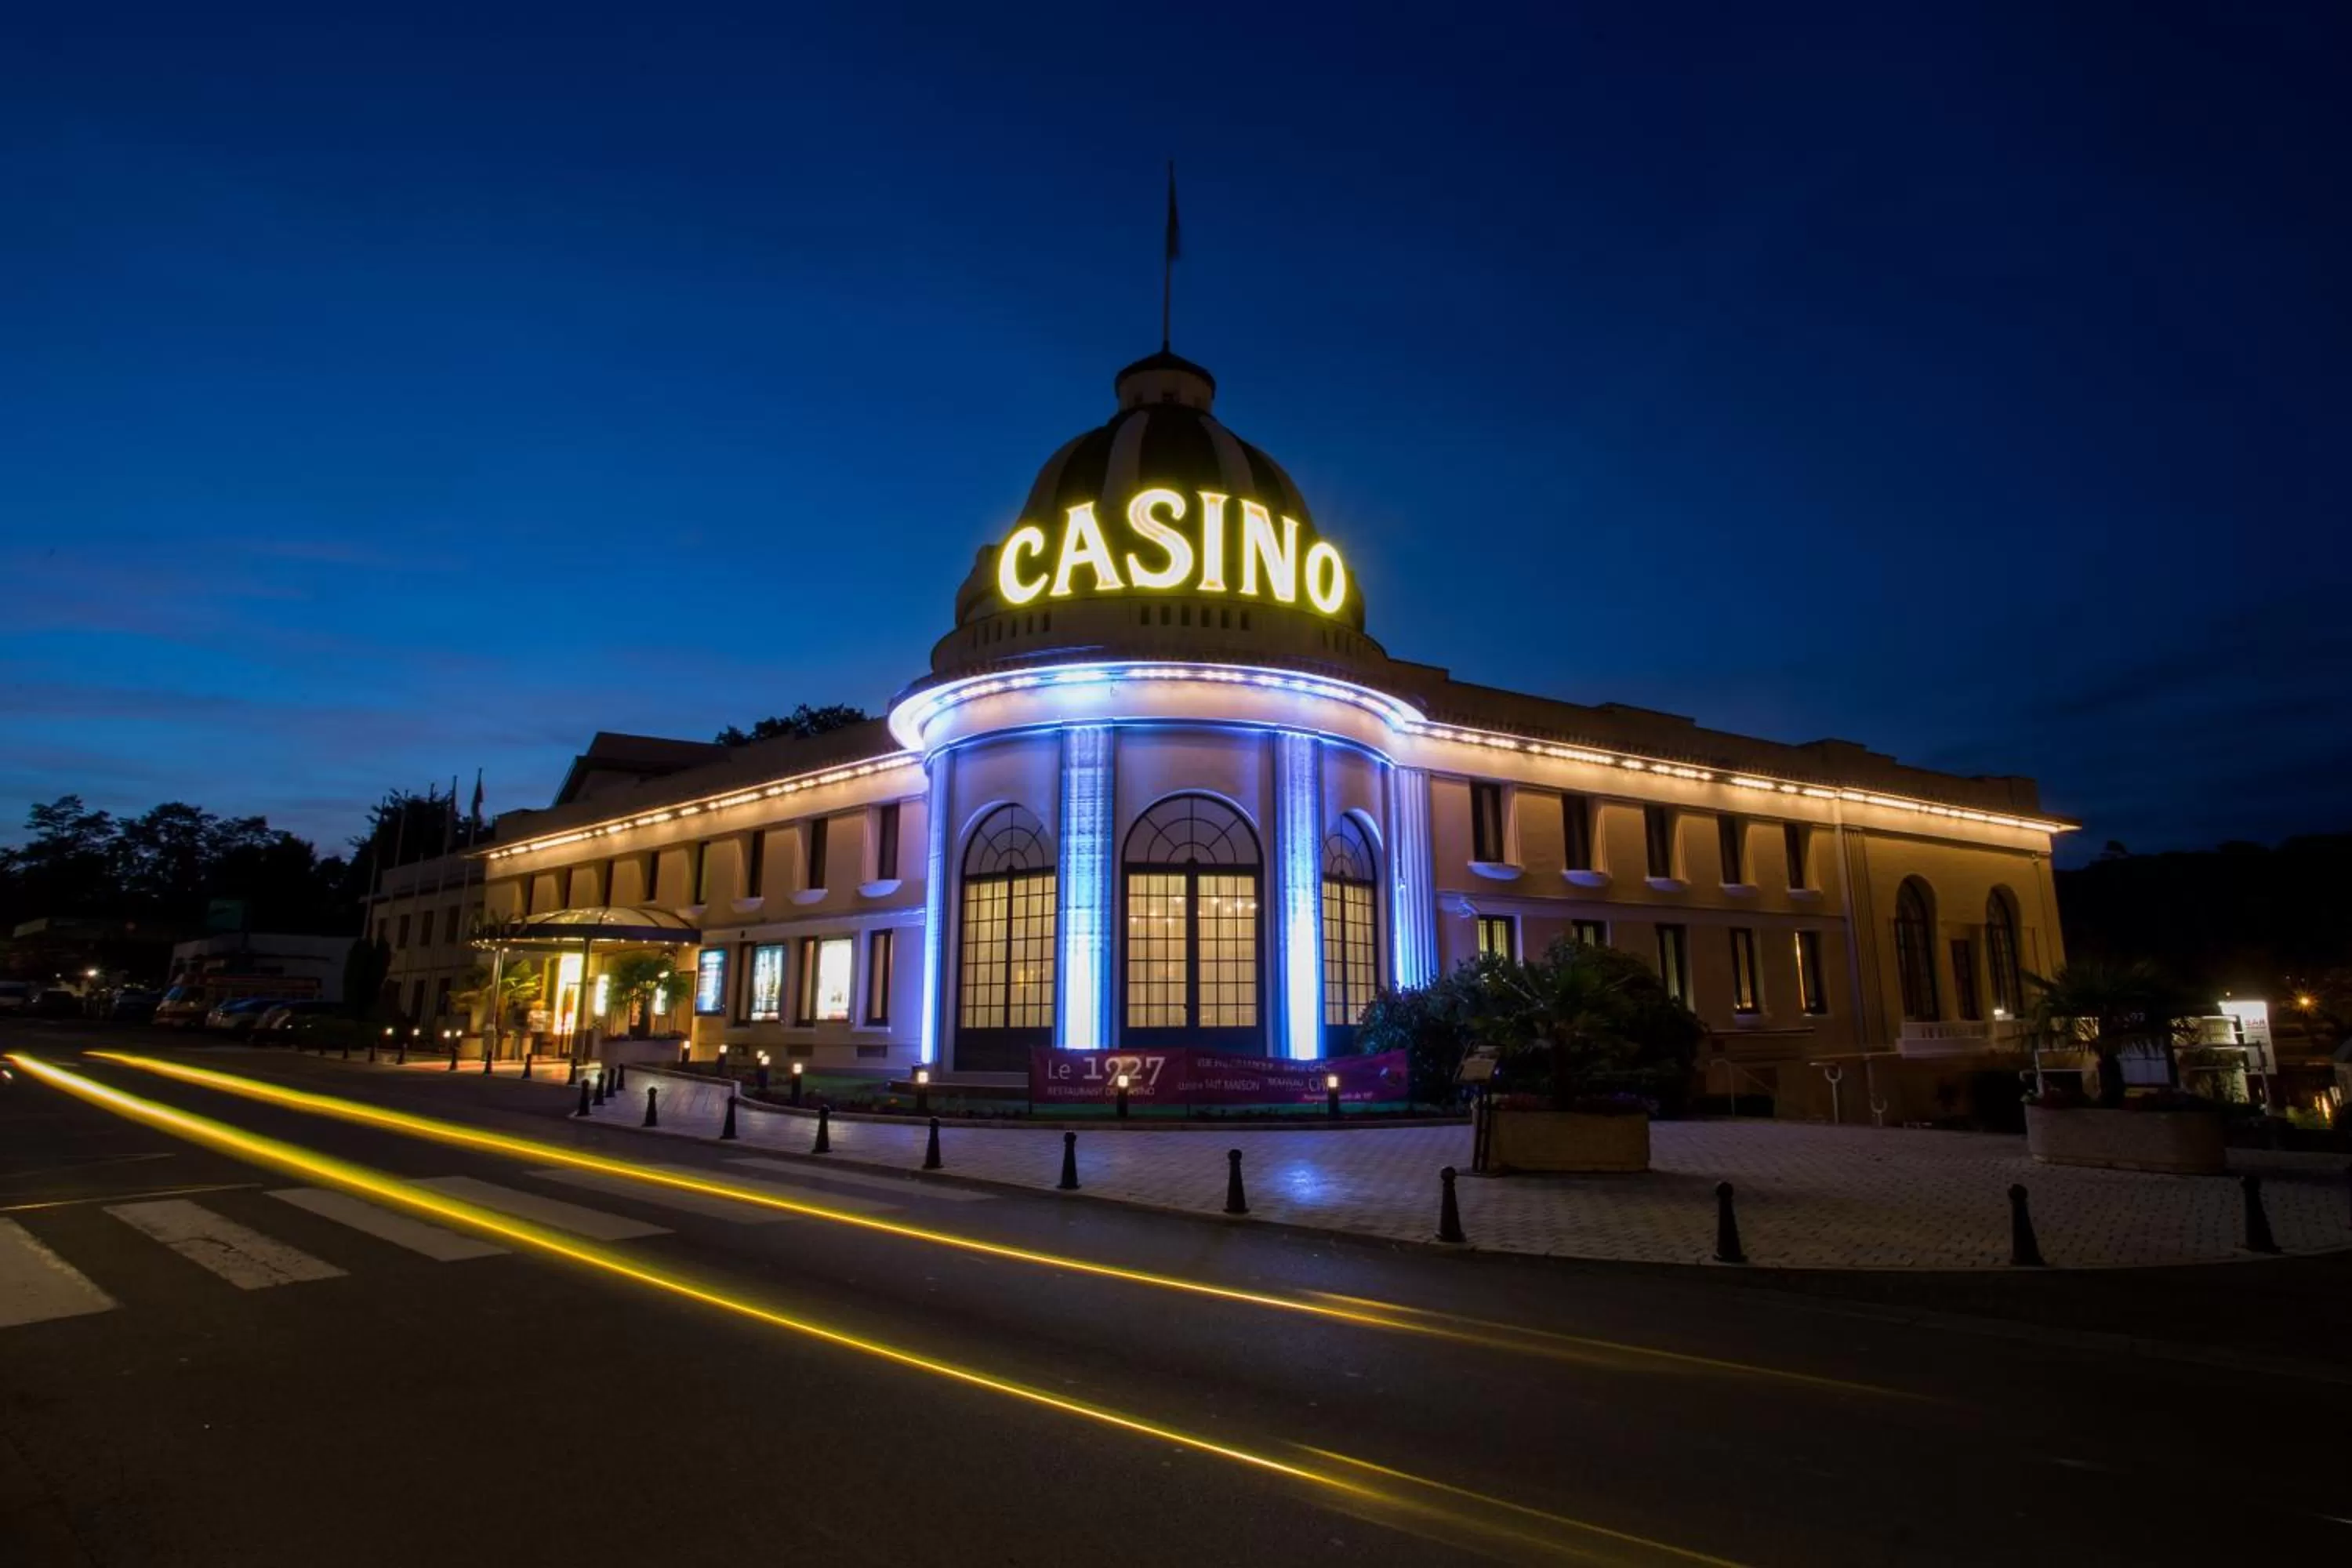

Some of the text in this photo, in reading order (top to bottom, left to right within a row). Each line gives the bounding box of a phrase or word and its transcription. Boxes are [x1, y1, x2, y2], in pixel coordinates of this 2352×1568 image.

[998, 488, 1346, 614] CASINO
[1047, 1058, 1071, 1080] Le
[1082, 1056, 1166, 1086] 1927
